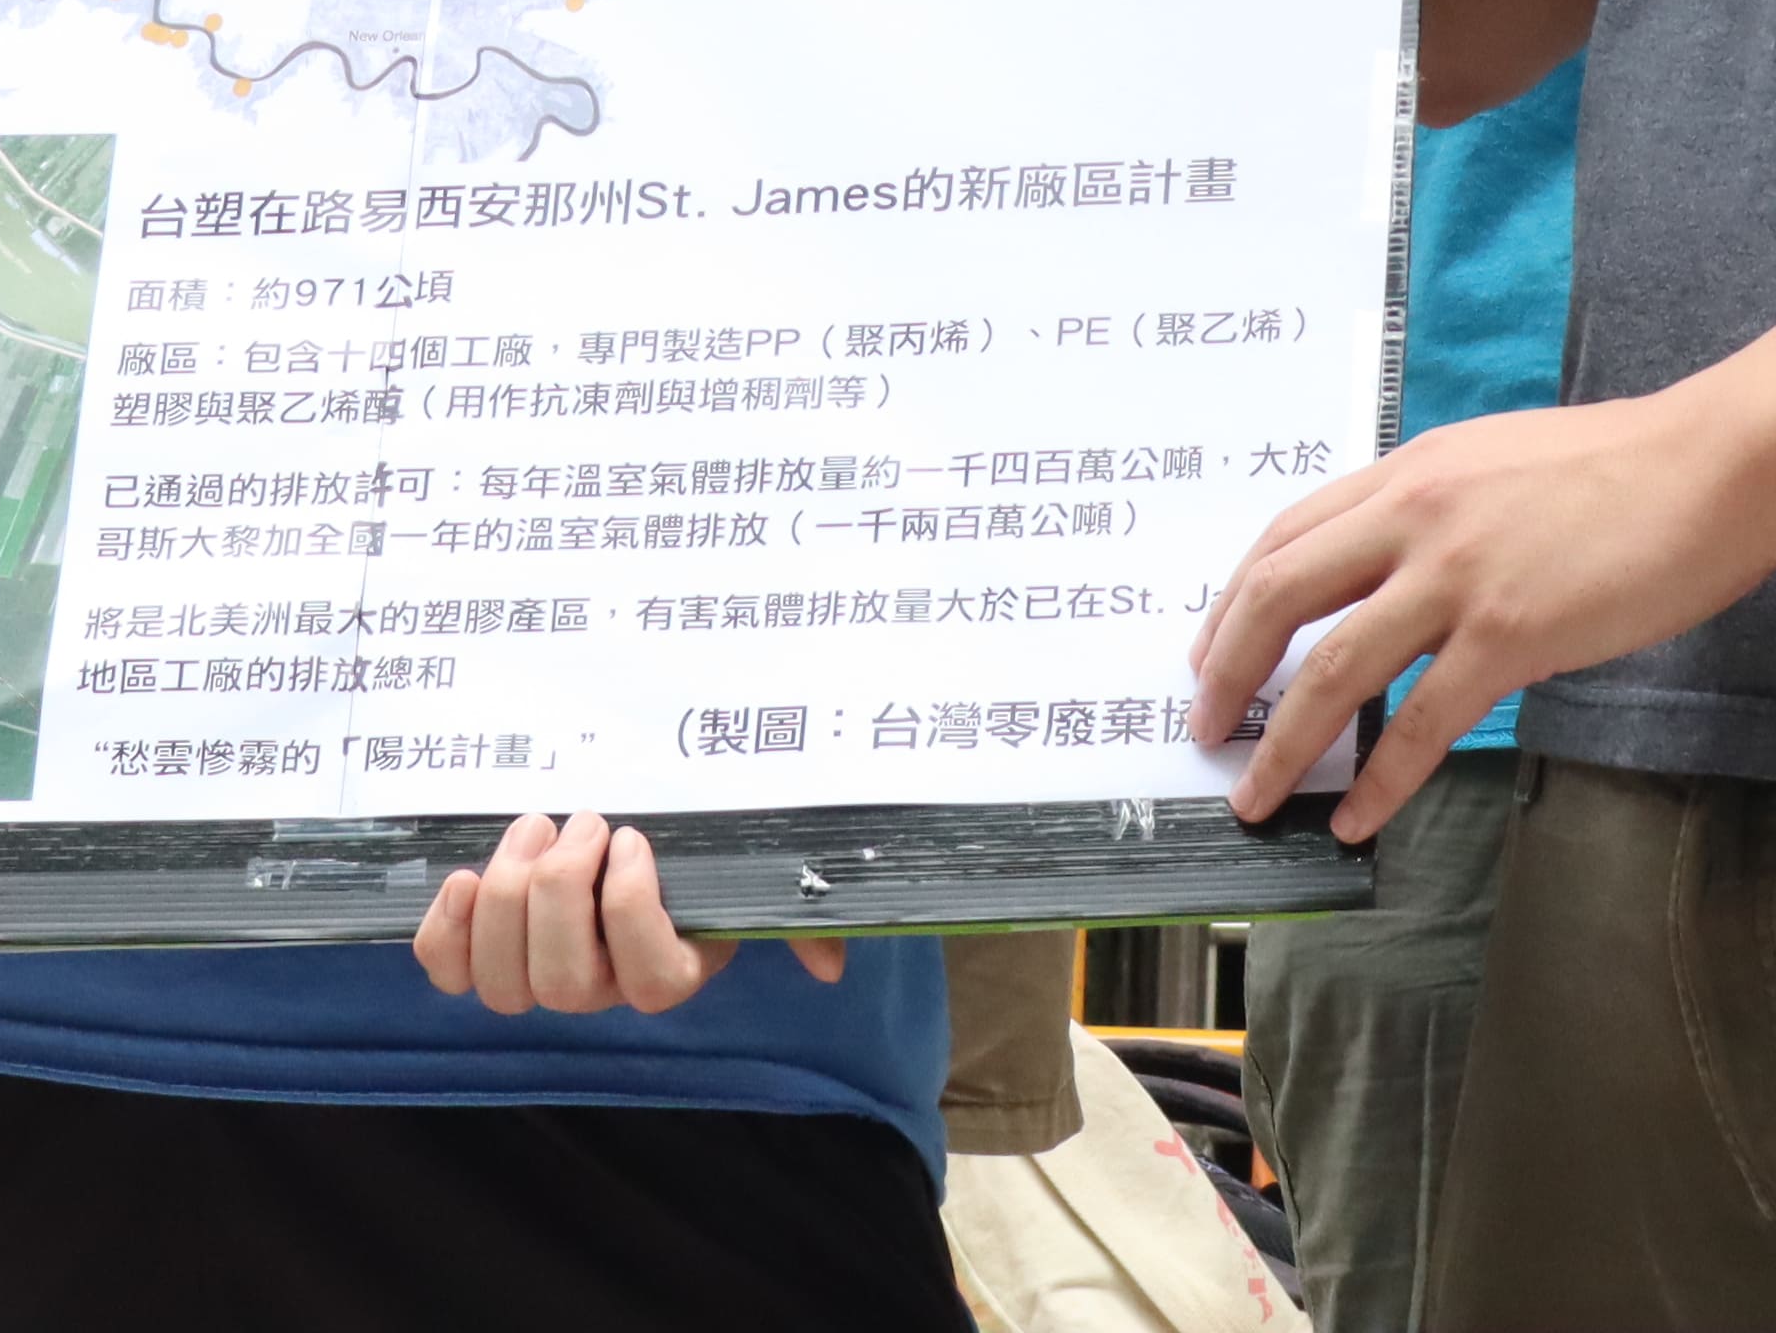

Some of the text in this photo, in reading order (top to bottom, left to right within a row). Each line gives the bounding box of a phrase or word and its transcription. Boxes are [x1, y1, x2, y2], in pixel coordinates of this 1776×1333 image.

[349, 30, 378, 43] New
[76, 655, 457, 695] 地區工廠的排放總和
